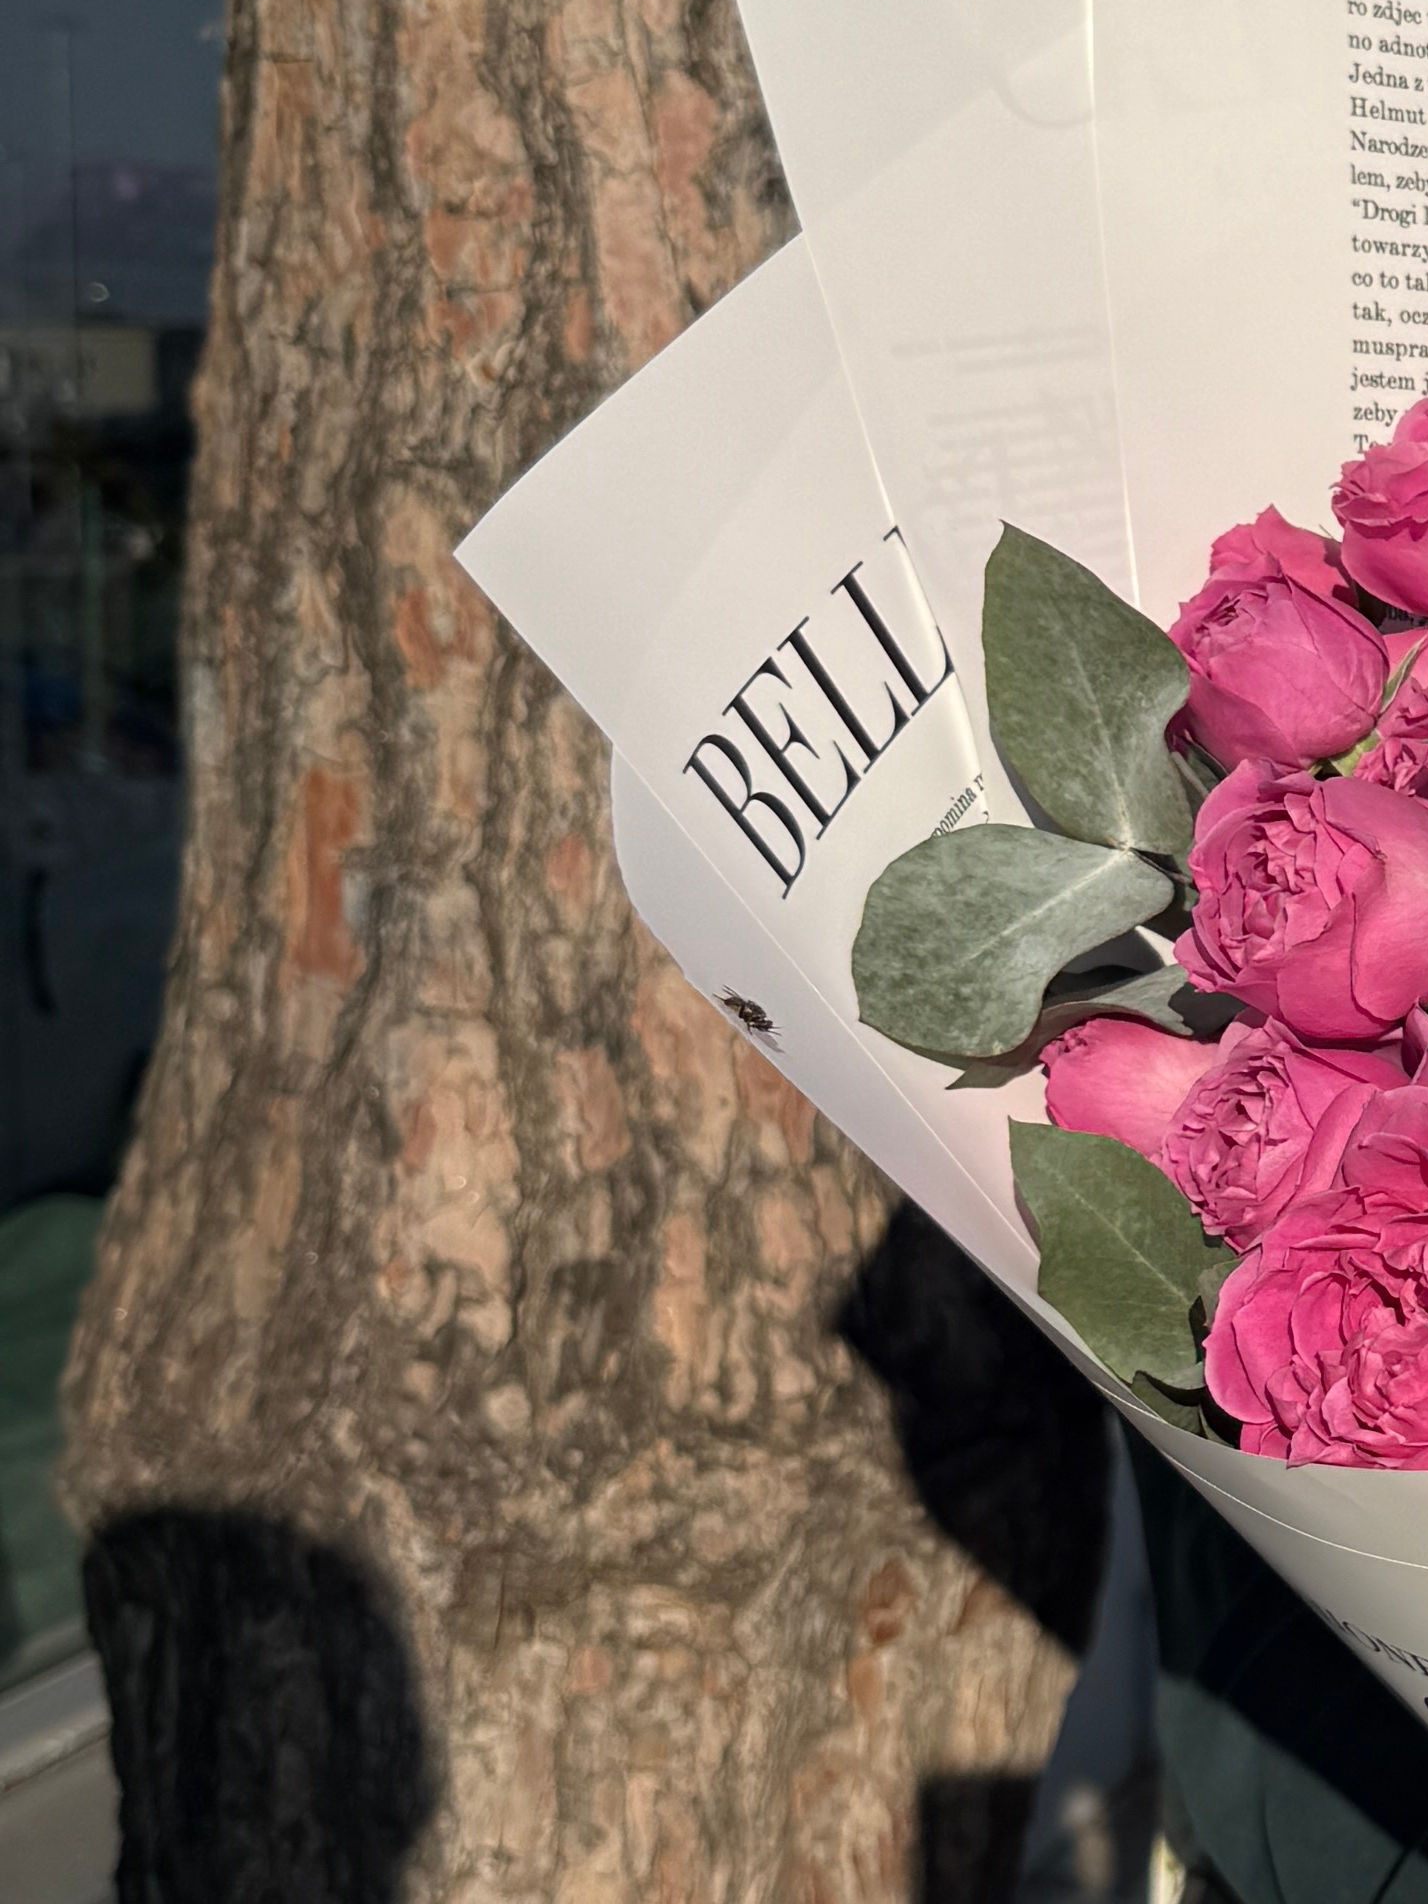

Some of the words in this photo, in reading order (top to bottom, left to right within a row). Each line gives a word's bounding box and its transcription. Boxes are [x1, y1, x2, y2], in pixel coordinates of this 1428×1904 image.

[1347, 0, 1368, 17] ro
[1372, 0, 1423, 27] zdjec
[1348, 34, 1373, 52] no
[1348, 62, 1410, 90] Jedna
[1414, 76, 1424, 92] z
[1350, 95, 1427, 126] Helmut
[1350, 163, 1391, 192] lem,
[682, 525, 956, 900] BELL
